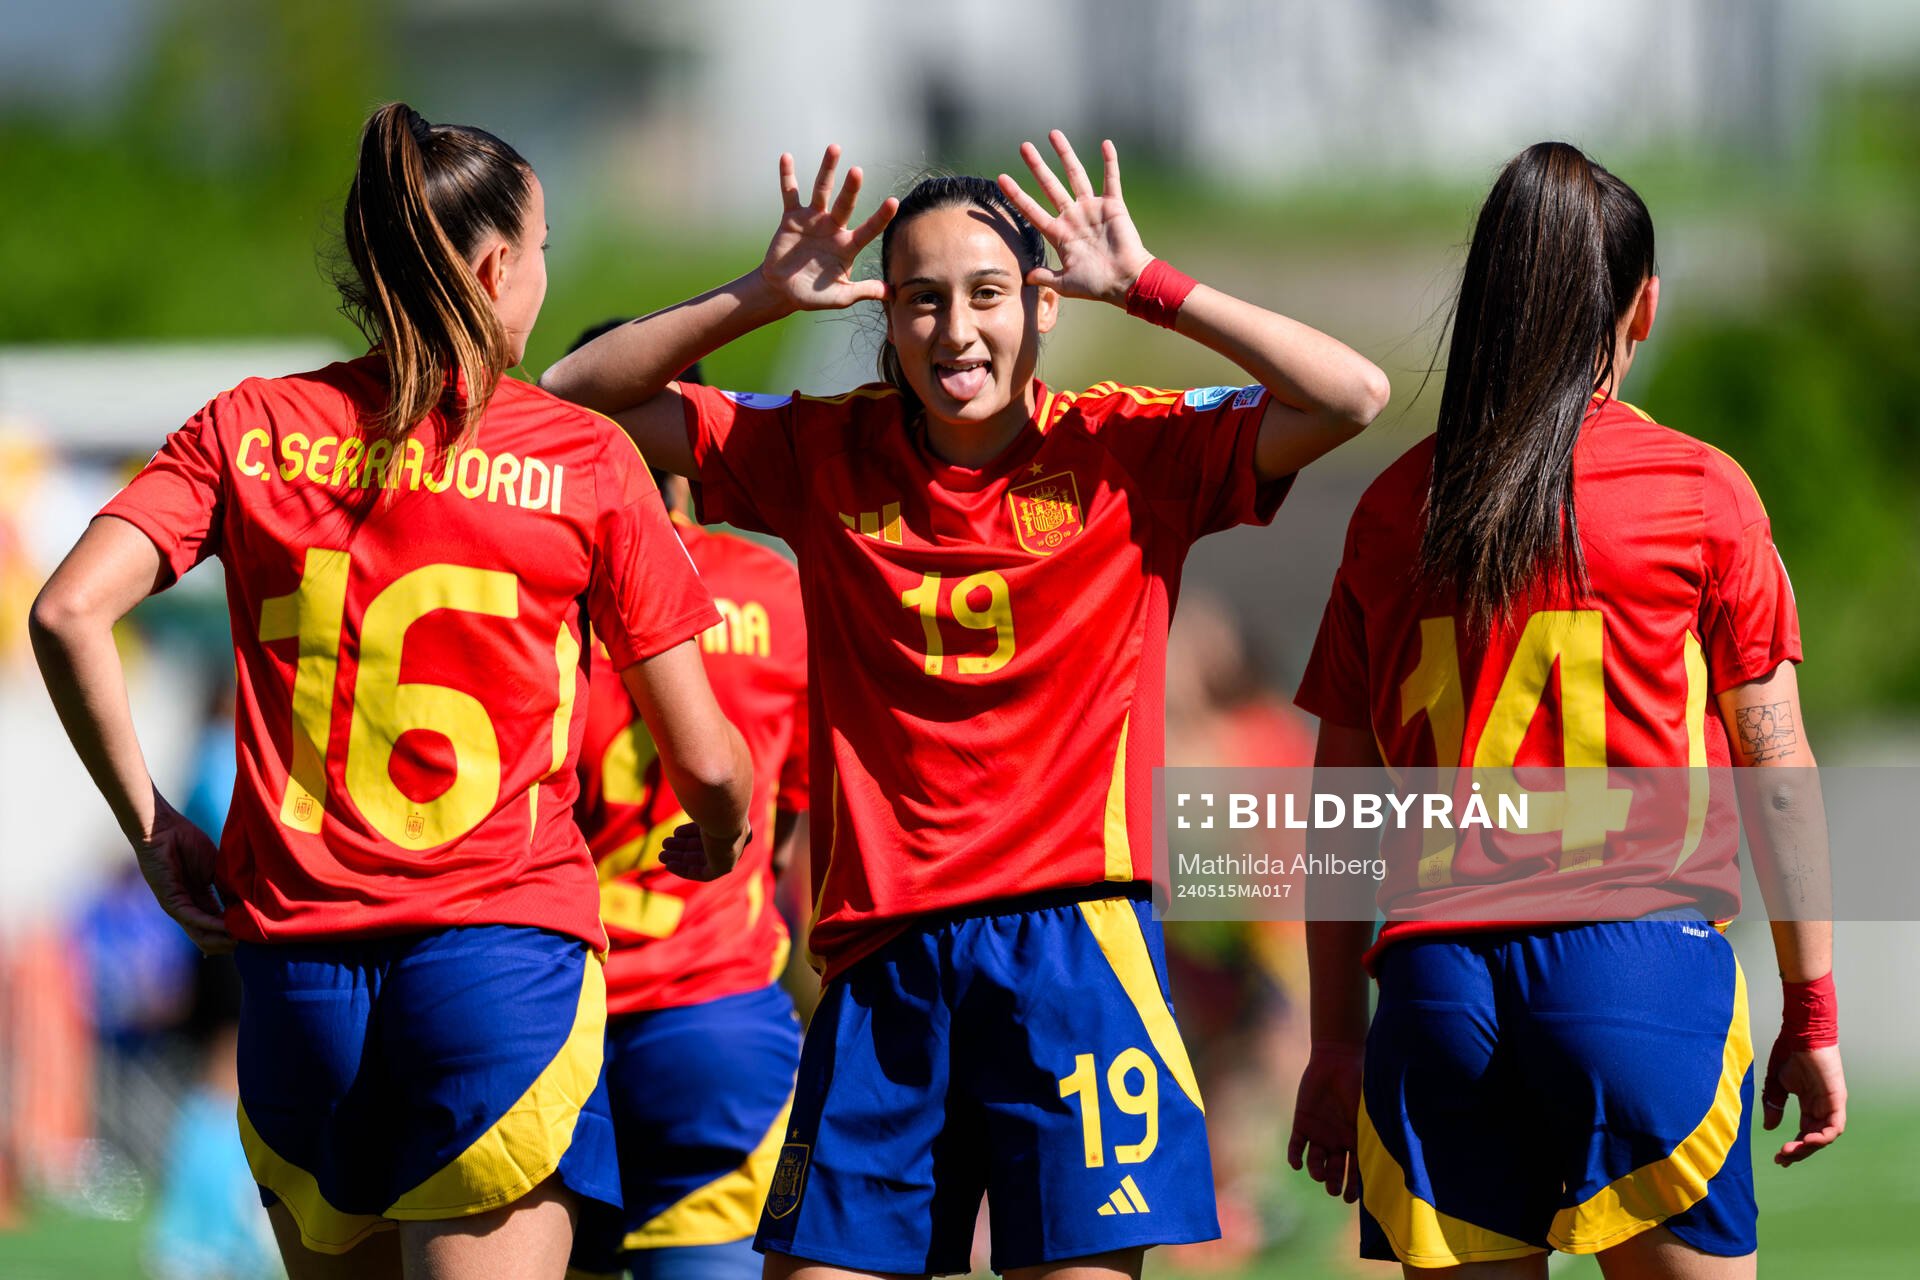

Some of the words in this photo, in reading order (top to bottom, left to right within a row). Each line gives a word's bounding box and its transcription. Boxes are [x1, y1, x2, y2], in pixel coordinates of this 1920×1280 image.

[258, 547, 519, 851] 16
[901, 570, 1016, 676] 19
[1400, 610, 1634, 889] 14
[1058, 1047, 1159, 1169] 19
